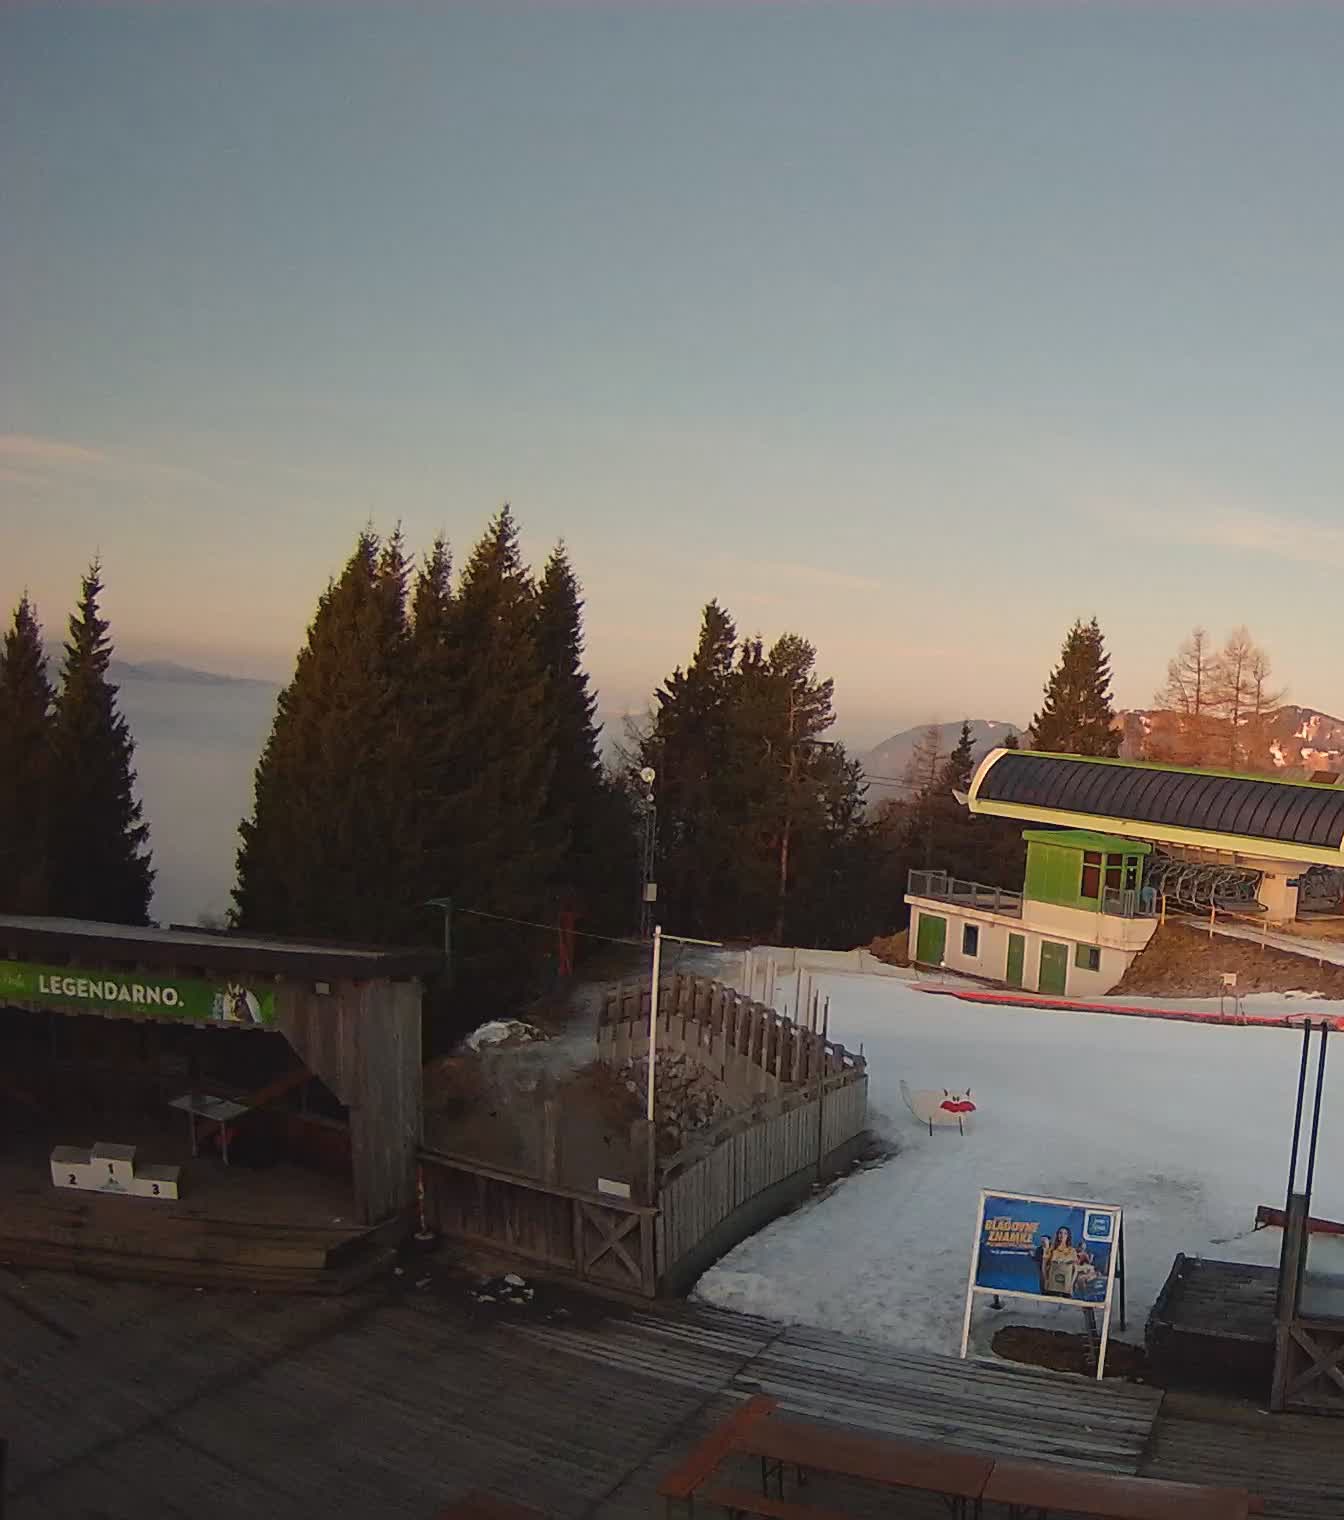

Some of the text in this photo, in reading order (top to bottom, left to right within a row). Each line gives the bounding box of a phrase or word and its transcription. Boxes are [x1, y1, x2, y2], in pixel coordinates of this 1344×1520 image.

[39, 974, 185, 1008] LEGENDARNO.
[107, 1163, 114, 1175] 1
[69, 1174, 76, 1185] 2
[152, 1184, 160, 1195] 3
